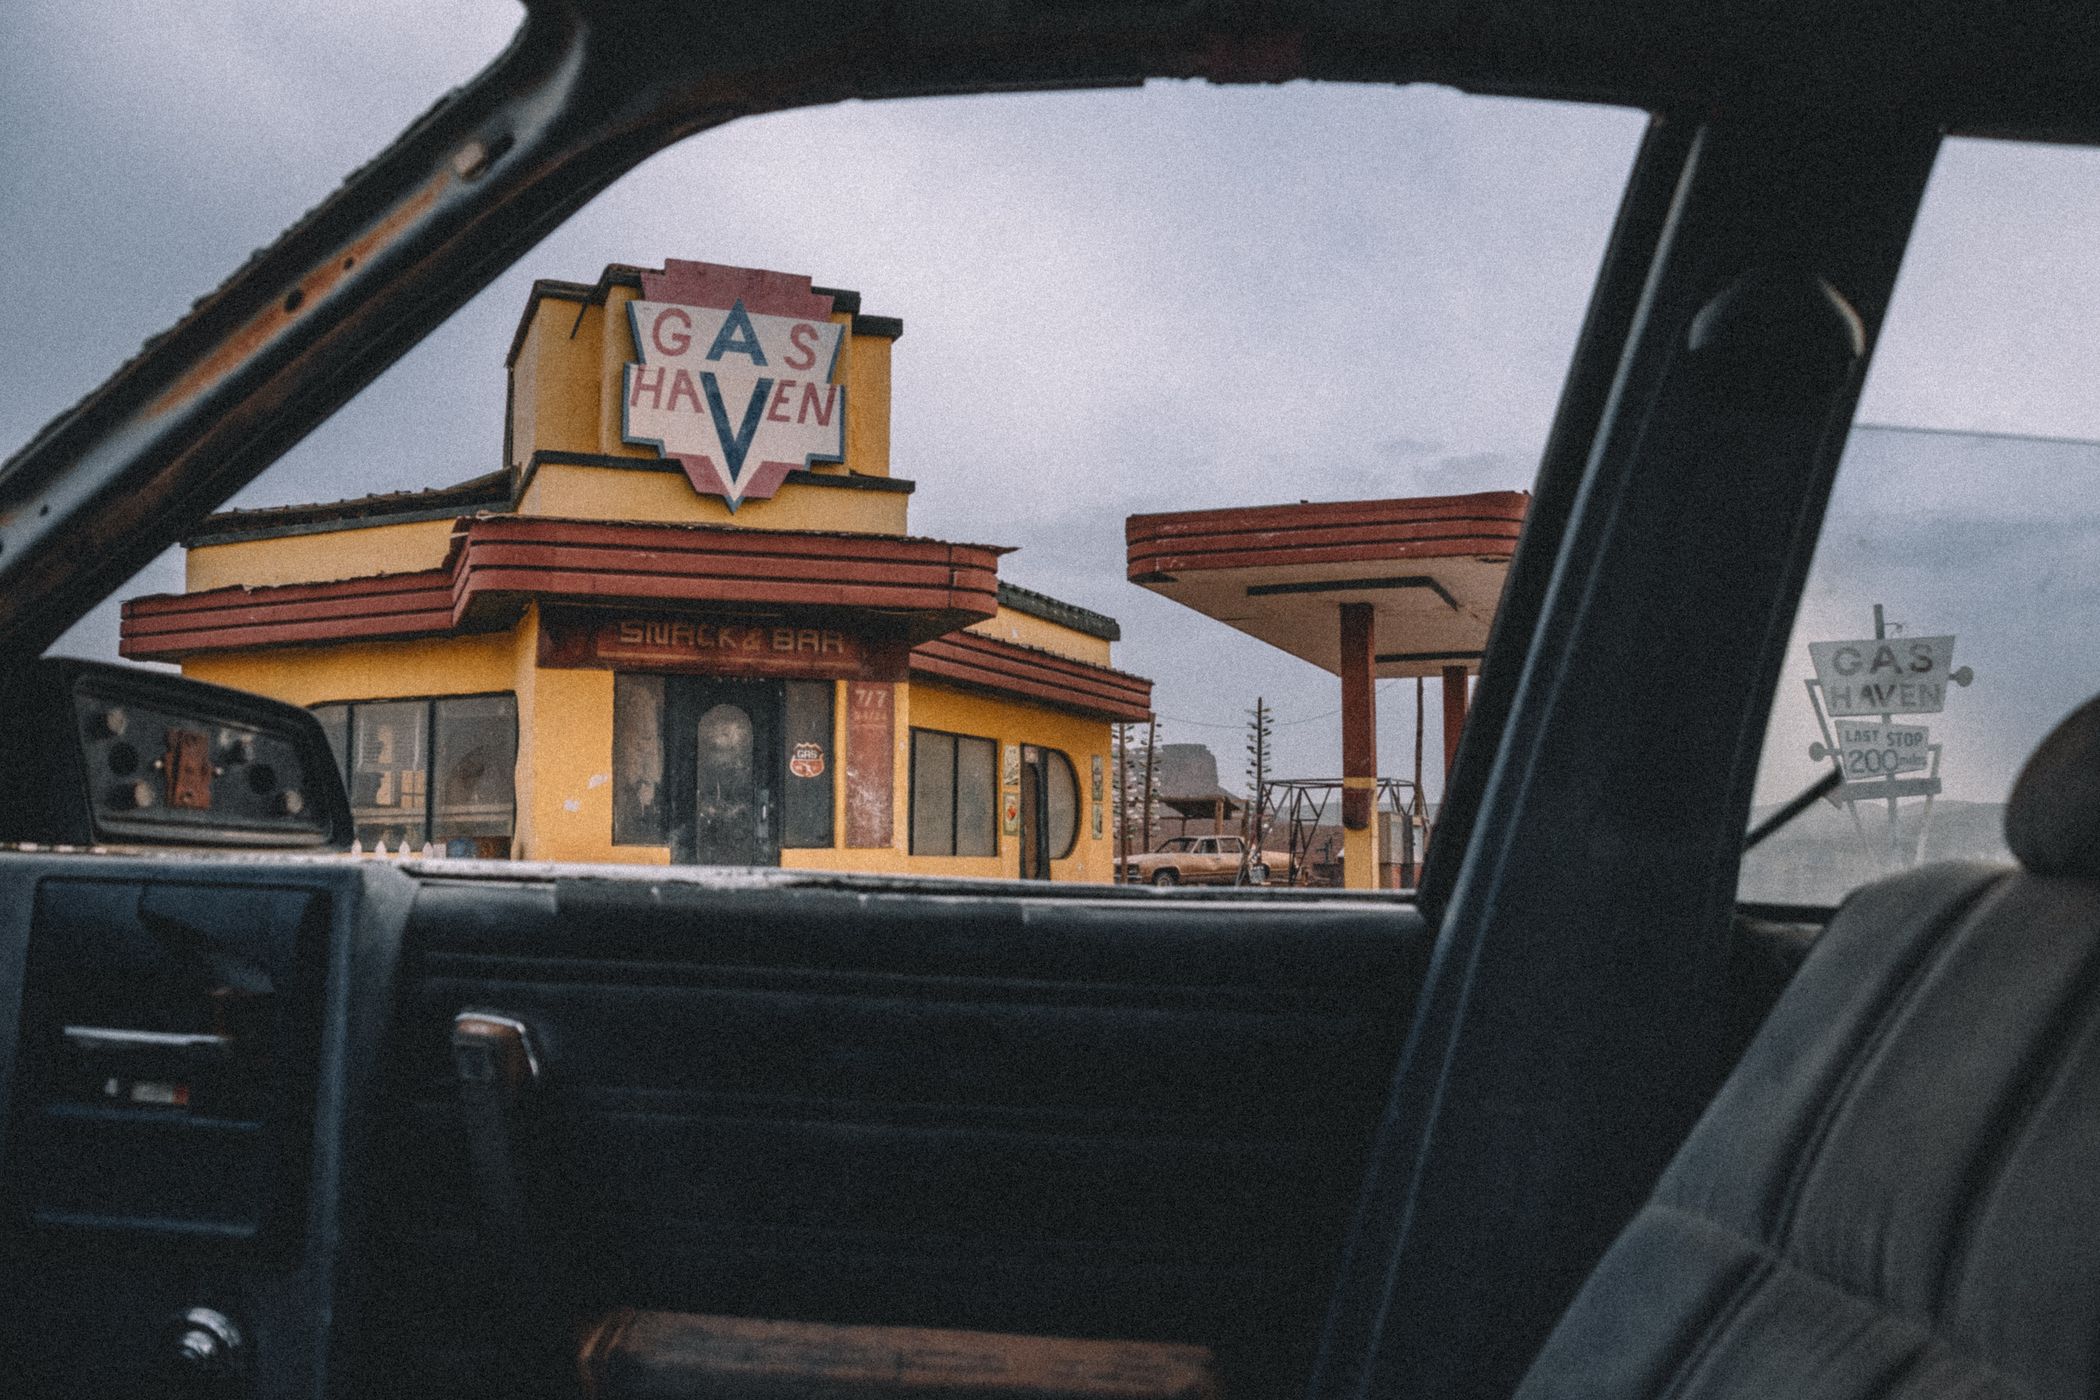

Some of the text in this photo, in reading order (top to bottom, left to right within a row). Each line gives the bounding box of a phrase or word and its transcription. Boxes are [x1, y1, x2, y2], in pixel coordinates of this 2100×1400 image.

[652, 299, 819, 371] GAS
[630, 365, 837, 484] HAVEN
[619, 620, 737, 649] SNACK
[772, 626, 845, 655] BAR
[1833, 643, 1934, 676] GAS
[1830, 684, 1941, 708] HAVEN
[1846, 730, 1924, 747] LAST STOP
[796, 749, 818, 760] GAS
[1849, 748, 1899, 773] 200
